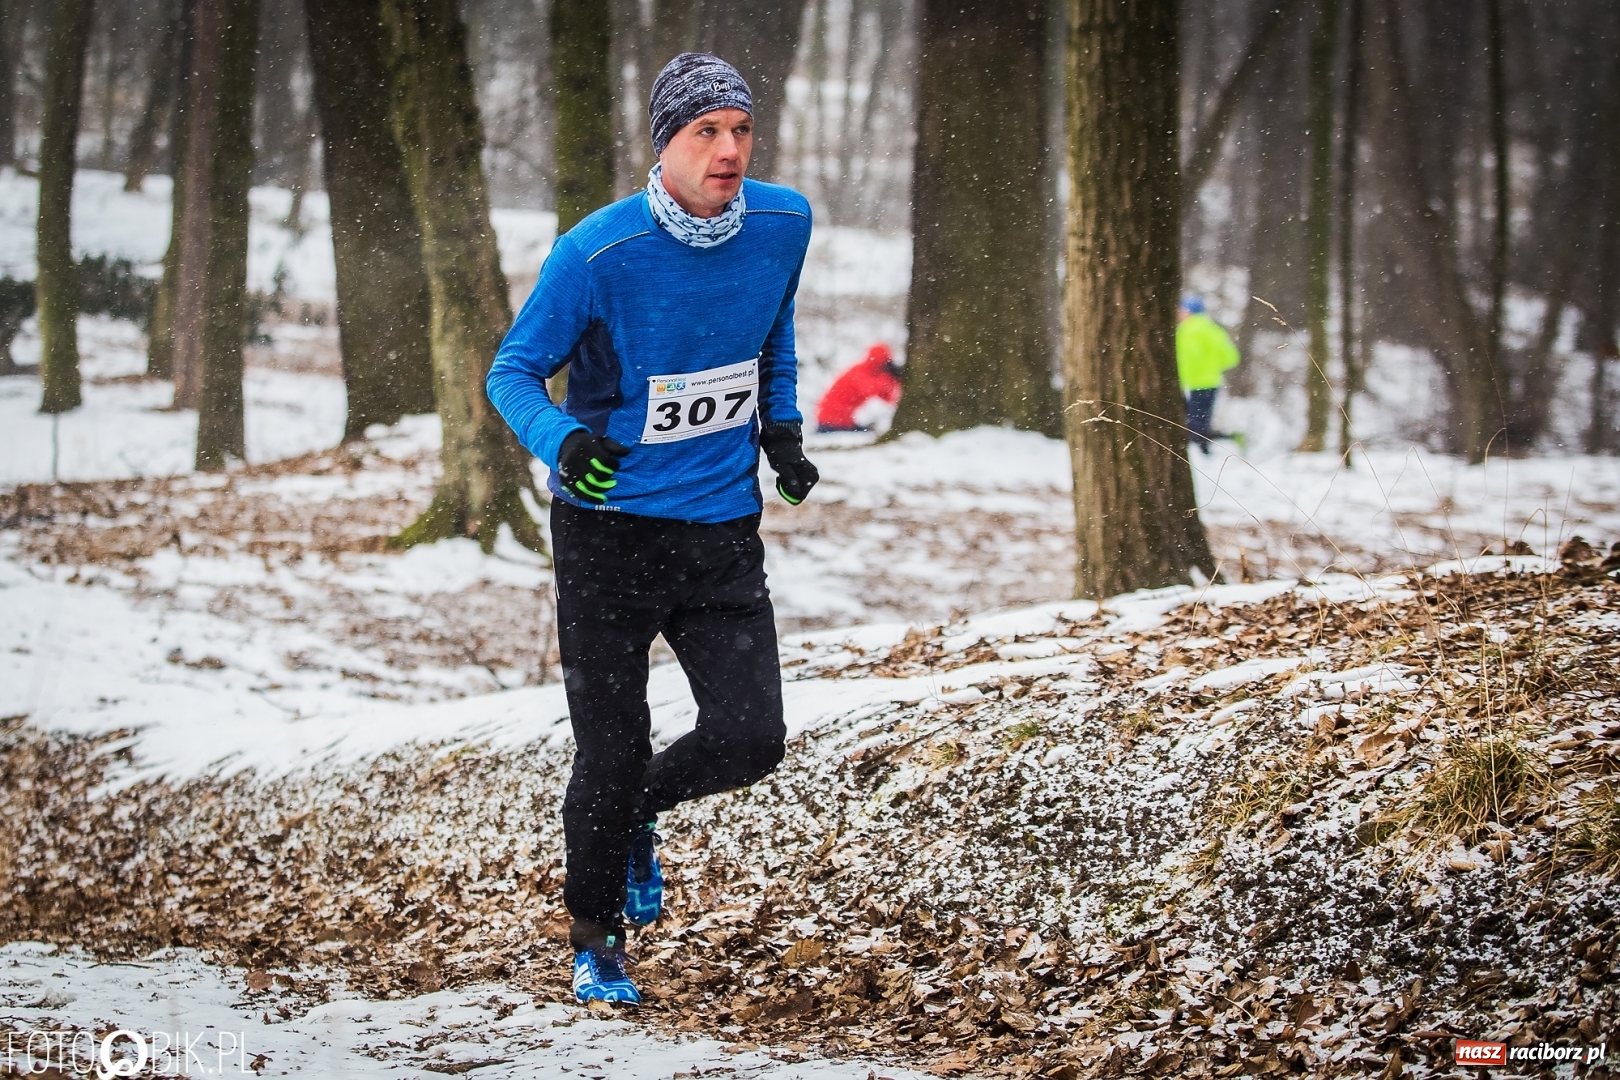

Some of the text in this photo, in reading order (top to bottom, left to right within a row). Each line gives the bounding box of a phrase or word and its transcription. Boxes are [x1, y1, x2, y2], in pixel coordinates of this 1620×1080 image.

[713, 81, 730, 92] Buff
[691, 368, 755, 387] www.personalbest.pl
[652, 390, 752, 432] 307
